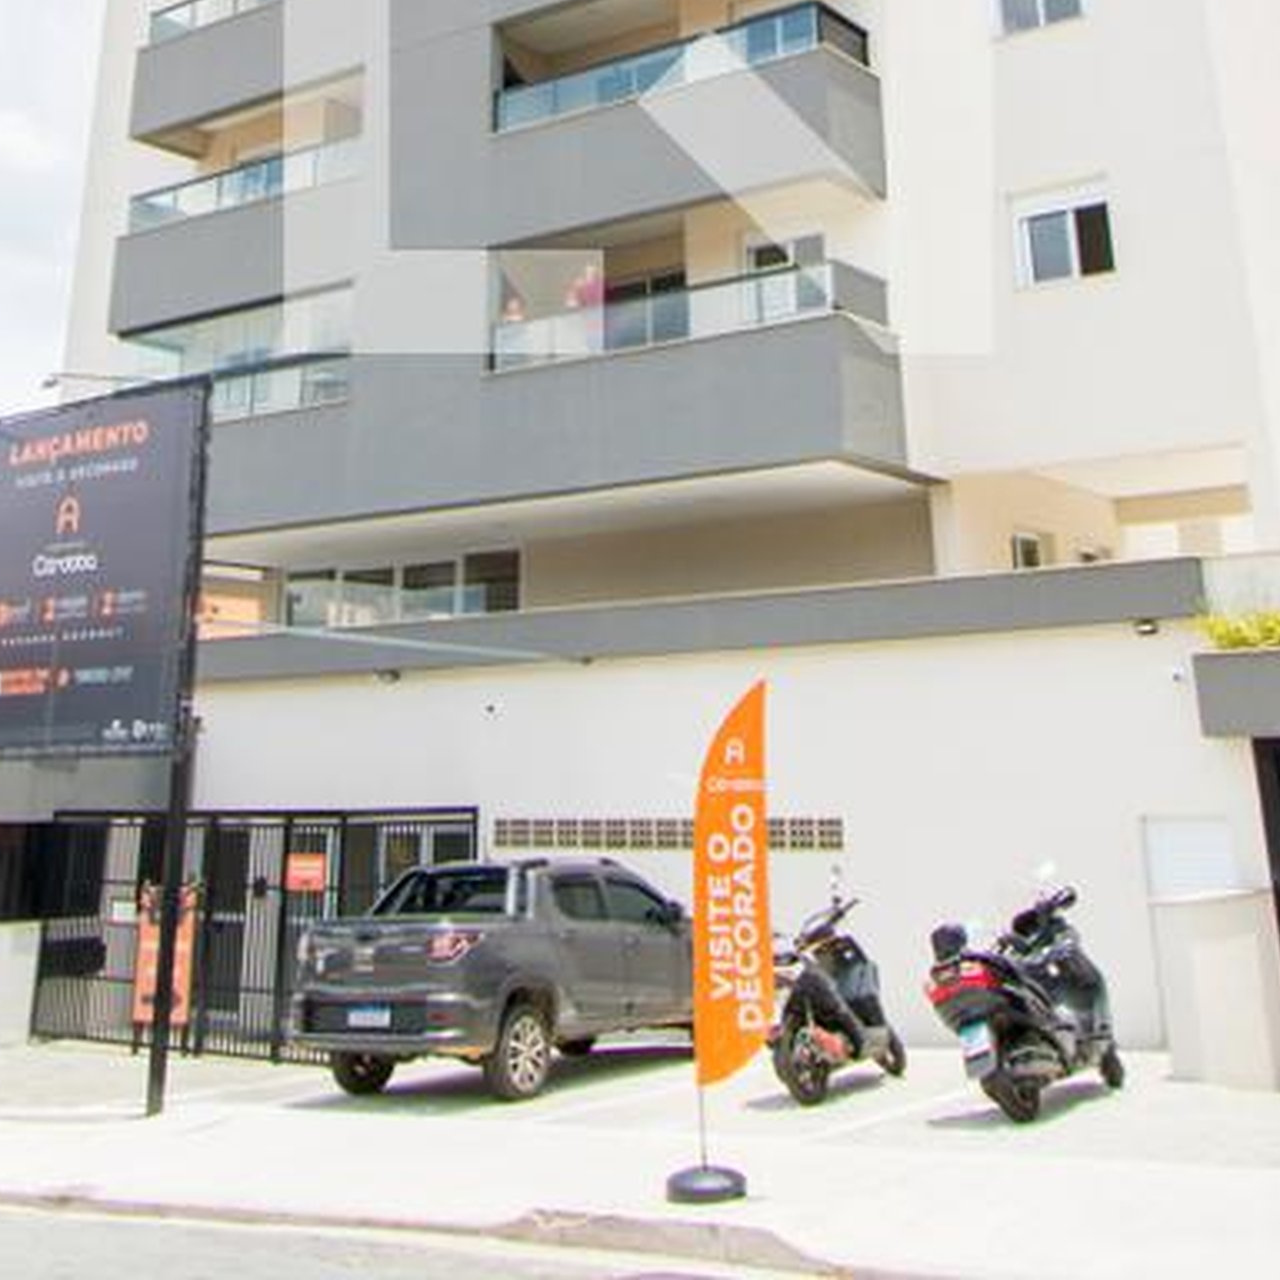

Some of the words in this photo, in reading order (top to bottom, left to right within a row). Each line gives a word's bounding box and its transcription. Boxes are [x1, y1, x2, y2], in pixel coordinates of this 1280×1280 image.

[9, 419, 149, 466] LANÇAMENTO
[707, 832, 732, 864] O
[707, 874, 734, 1000] VISITE
[731, 803, 763, 1033] DECORADO
